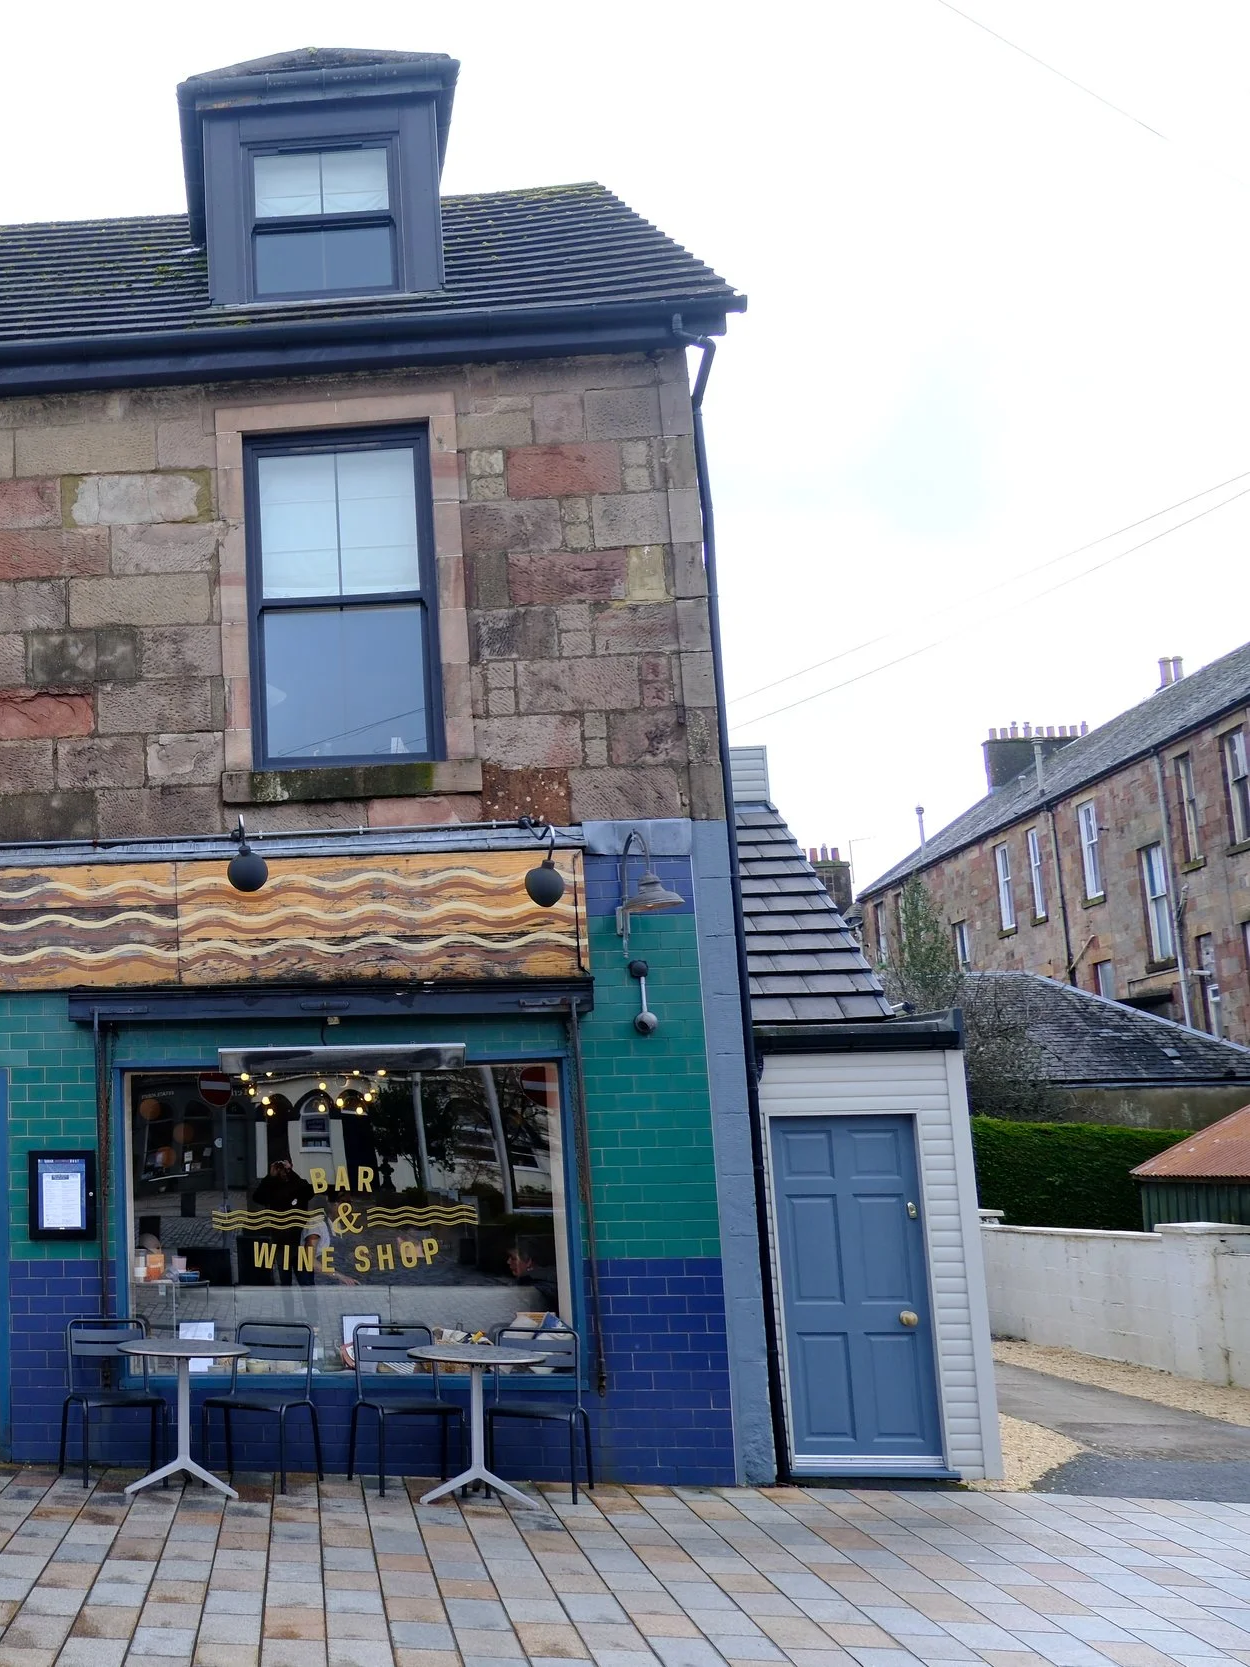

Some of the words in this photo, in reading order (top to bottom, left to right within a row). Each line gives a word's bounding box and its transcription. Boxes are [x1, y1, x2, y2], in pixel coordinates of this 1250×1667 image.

[309, 1166, 374, 1194] BAR
[332, 1202, 363, 1235] &
[253, 1241, 336, 1273] WINE
[354, 1237, 440, 1273] SHOP
